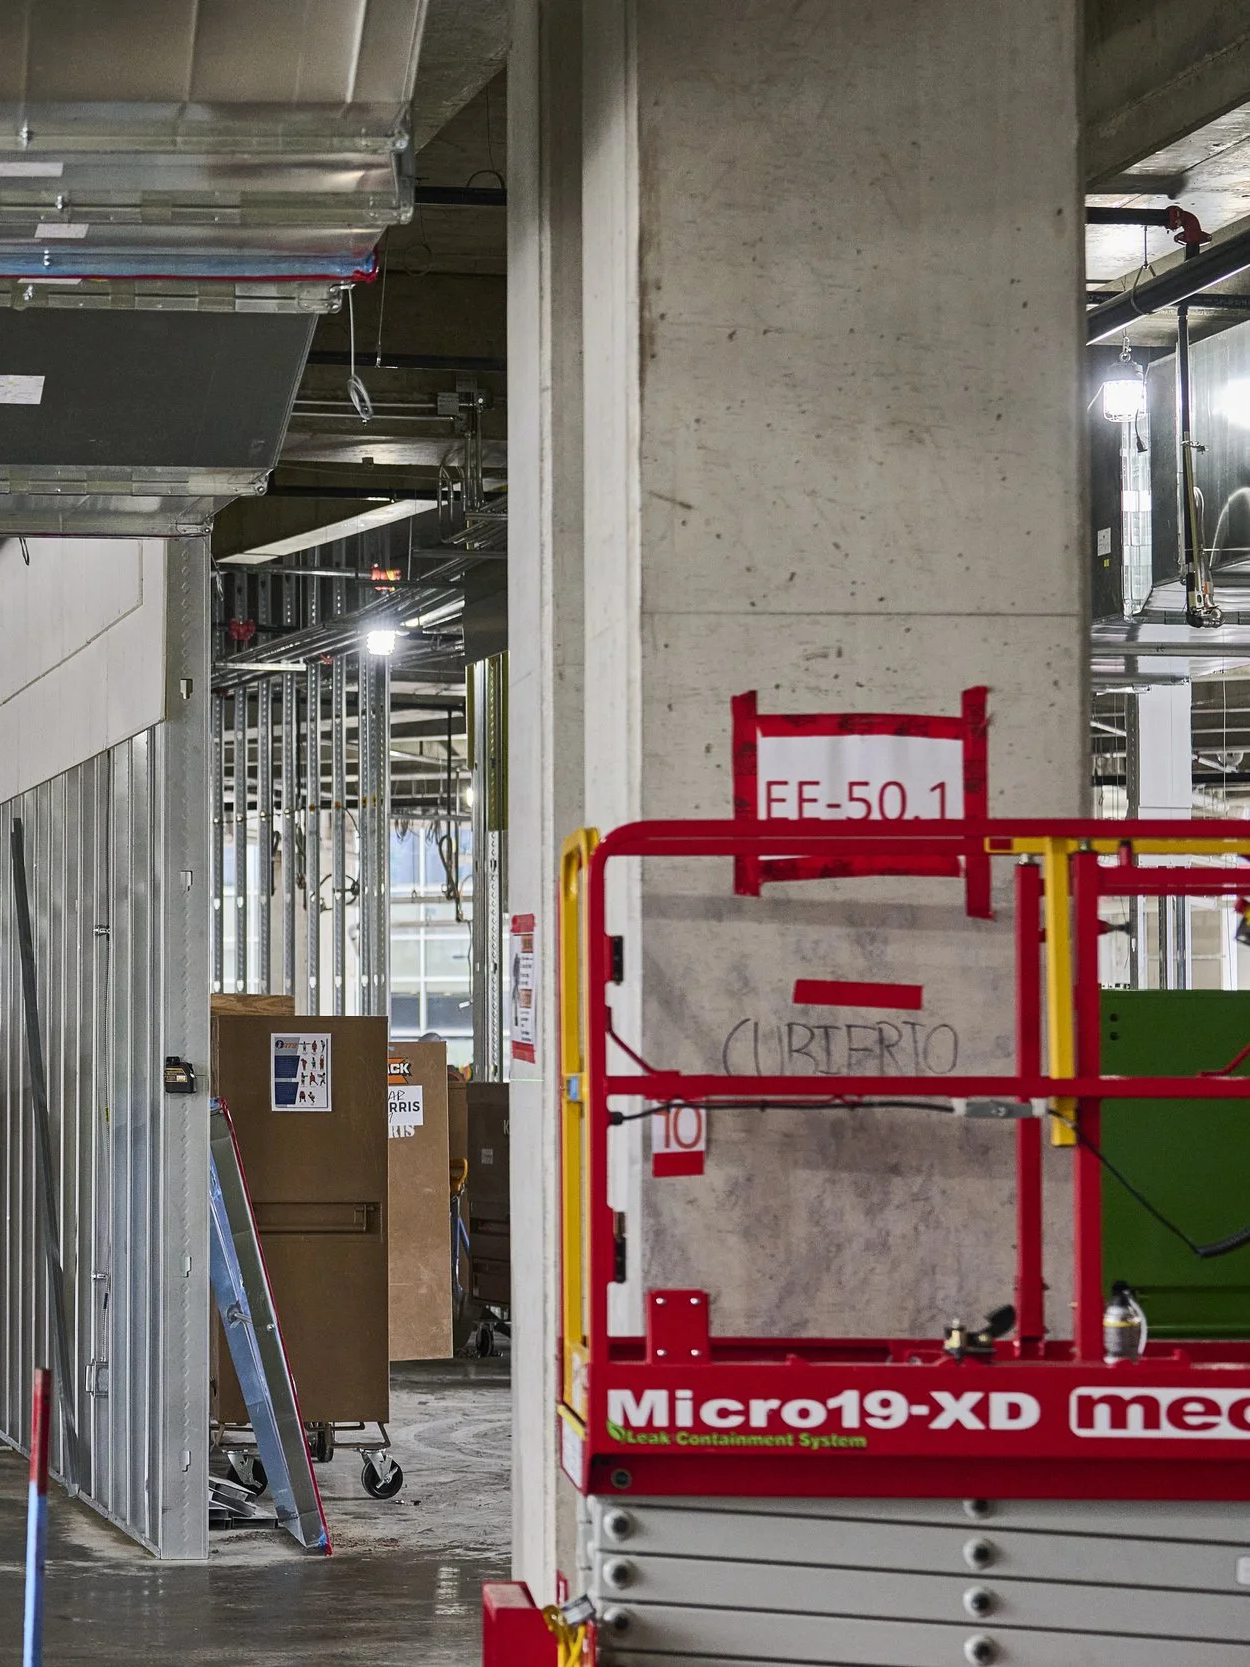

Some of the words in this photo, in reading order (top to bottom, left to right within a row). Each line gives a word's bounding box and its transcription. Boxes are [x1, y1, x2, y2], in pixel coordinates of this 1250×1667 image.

[766, 780, 946, 820] EE-50.1
[722, 1017, 959, 1077] CUBIERTO
[388, 1101, 421, 1113] RRIS
[388, 1124, 416, 1138] RIS
[607, 1389, 1041, 1430] Micro19-XD
[627, 1431, 671, 1445] Leak
[676, 1431, 793, 1447] Containment
[798, 1433, 868, 1450] System
